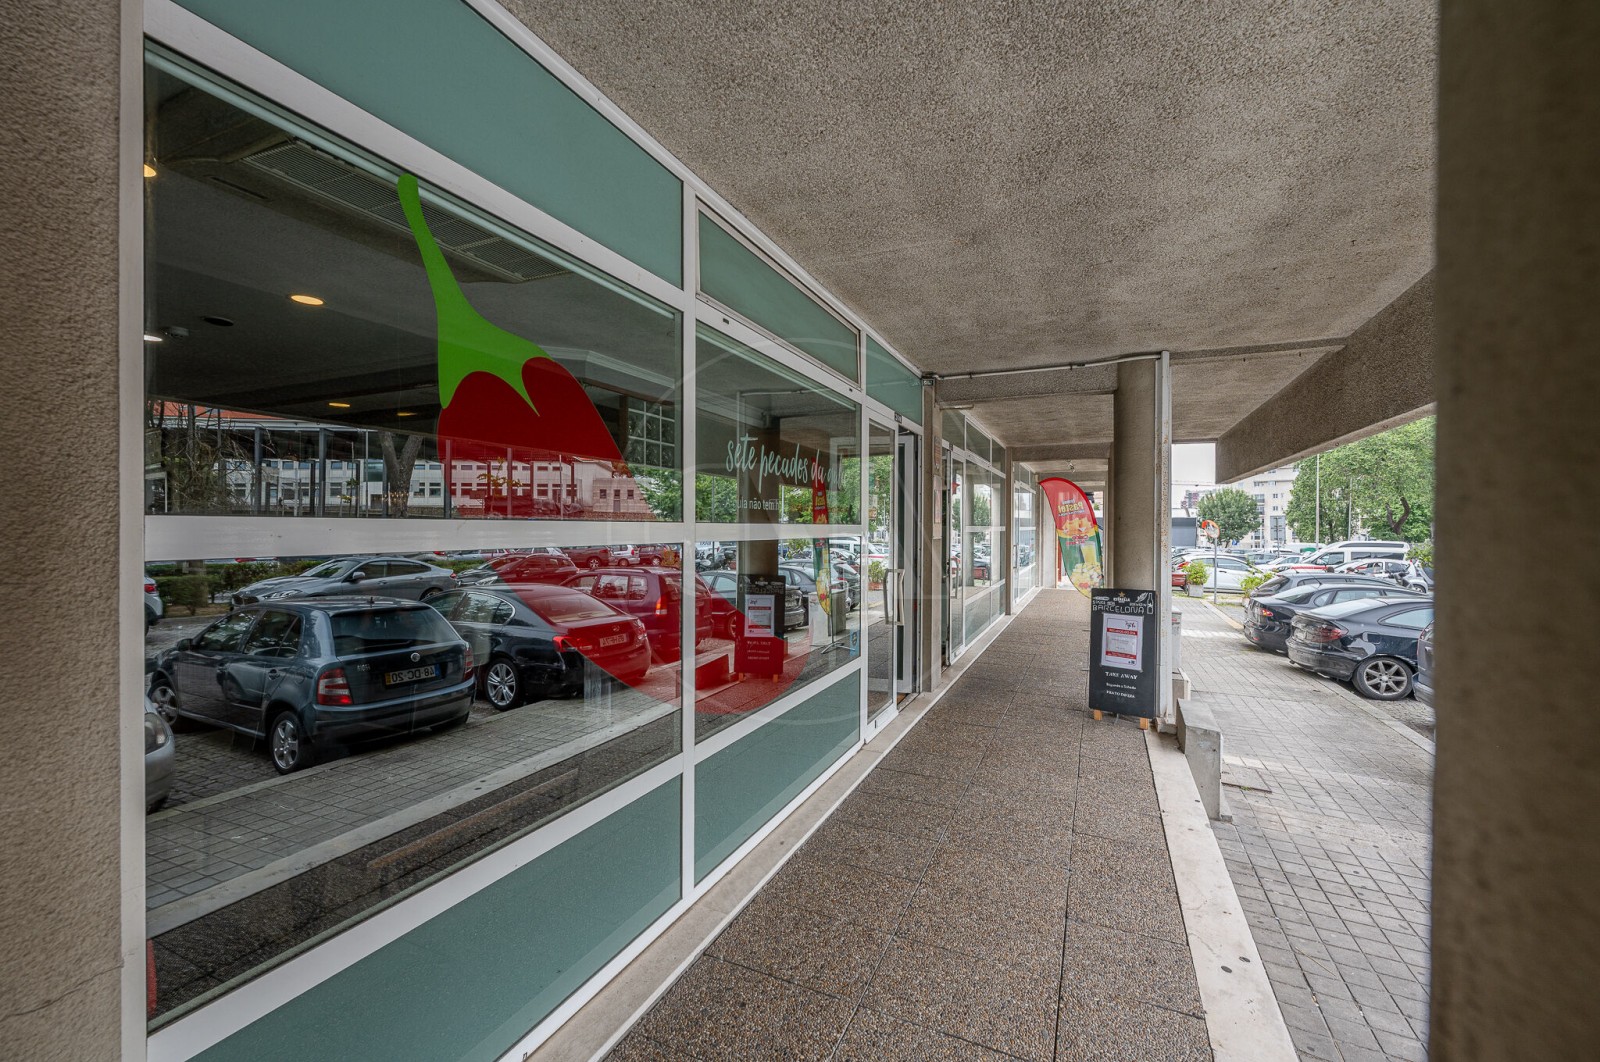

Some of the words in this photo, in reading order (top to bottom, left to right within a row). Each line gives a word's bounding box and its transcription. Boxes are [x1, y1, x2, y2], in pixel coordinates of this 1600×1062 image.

[726, 432, 758, 472] sete
[758, 442, 809, 494] pecados
[811, 448, 827, 488] da
[749, 497, 762, 510] não
[762, 499, 775, 511] tem
[1092, 604, 1145, 614] BARCELONA
